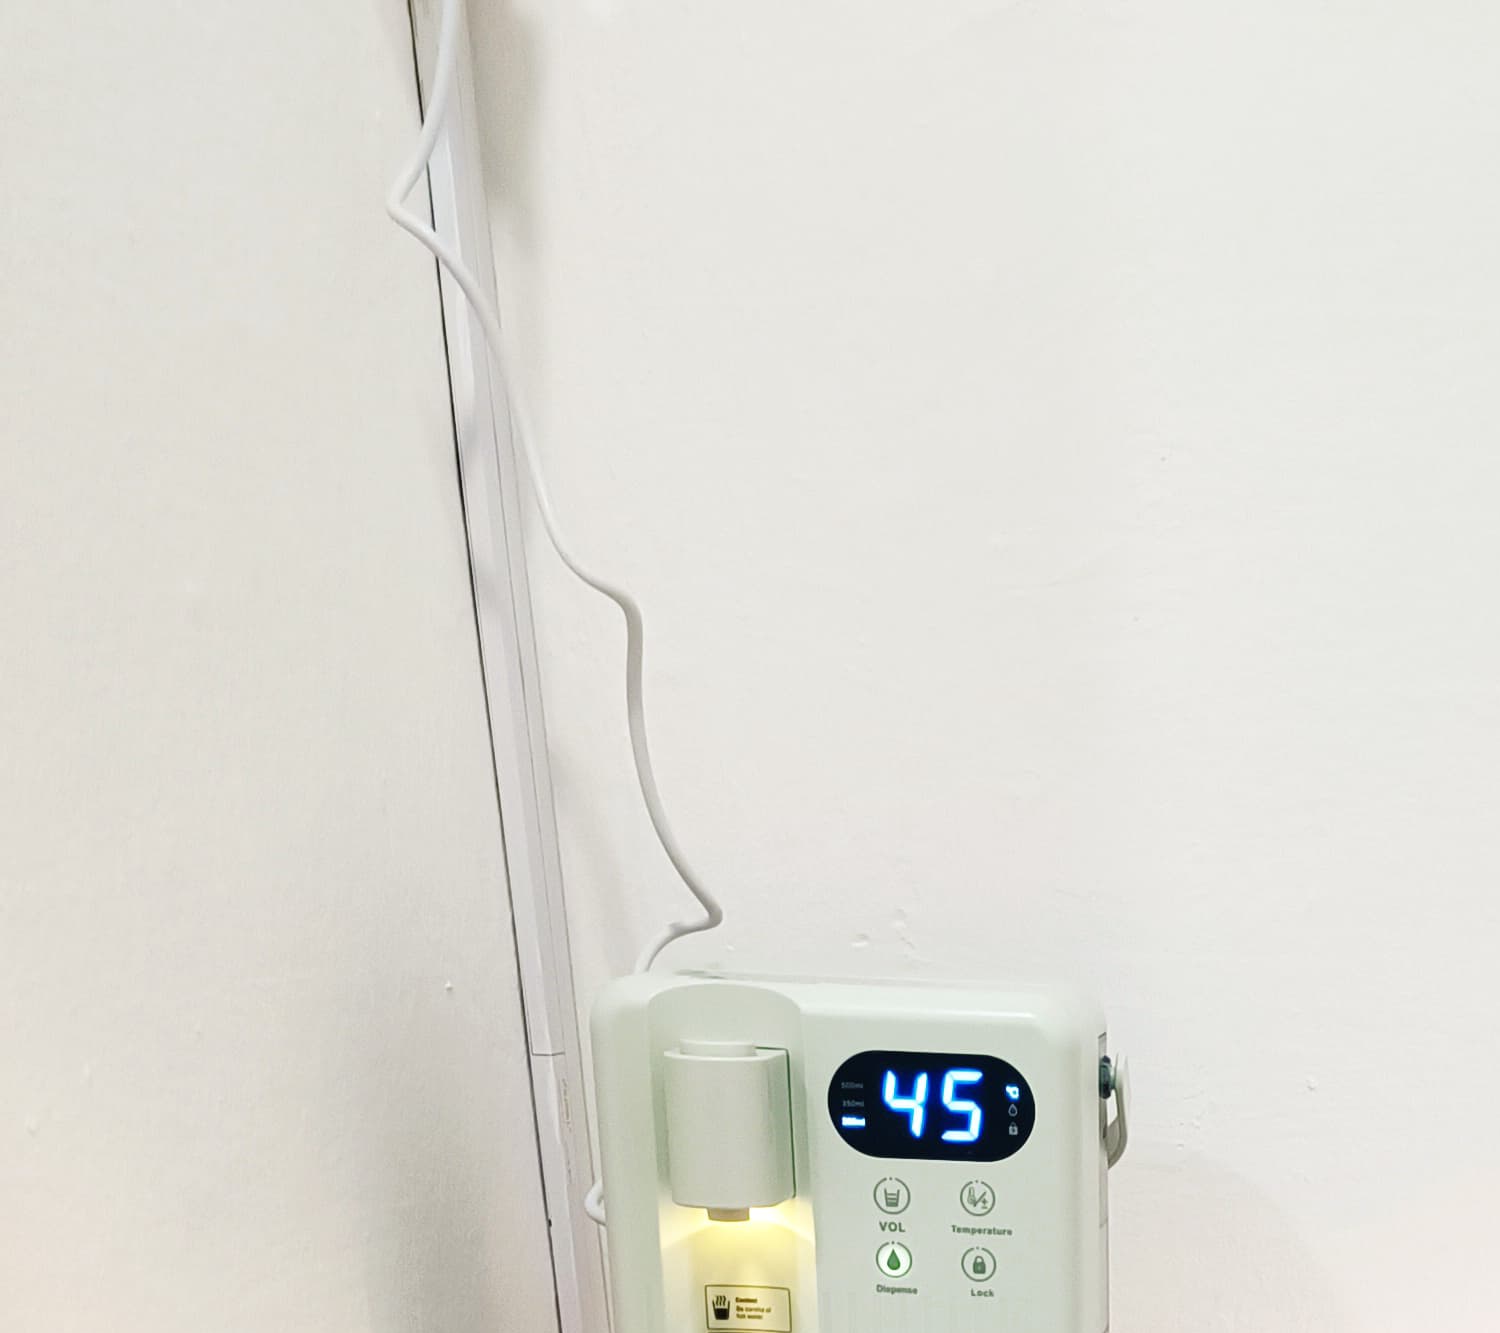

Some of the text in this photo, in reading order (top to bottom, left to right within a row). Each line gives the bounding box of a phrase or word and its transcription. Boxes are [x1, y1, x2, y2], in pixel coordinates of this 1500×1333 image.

[883, 1069, 984, 1142] 45
[879, 1221, 906, 1233] VOL
[951, 1224, 1013, 1236] Temperature
[876, 1284, 918, 1295] Dispense
[971, 1288, 995, 1298] Lock
